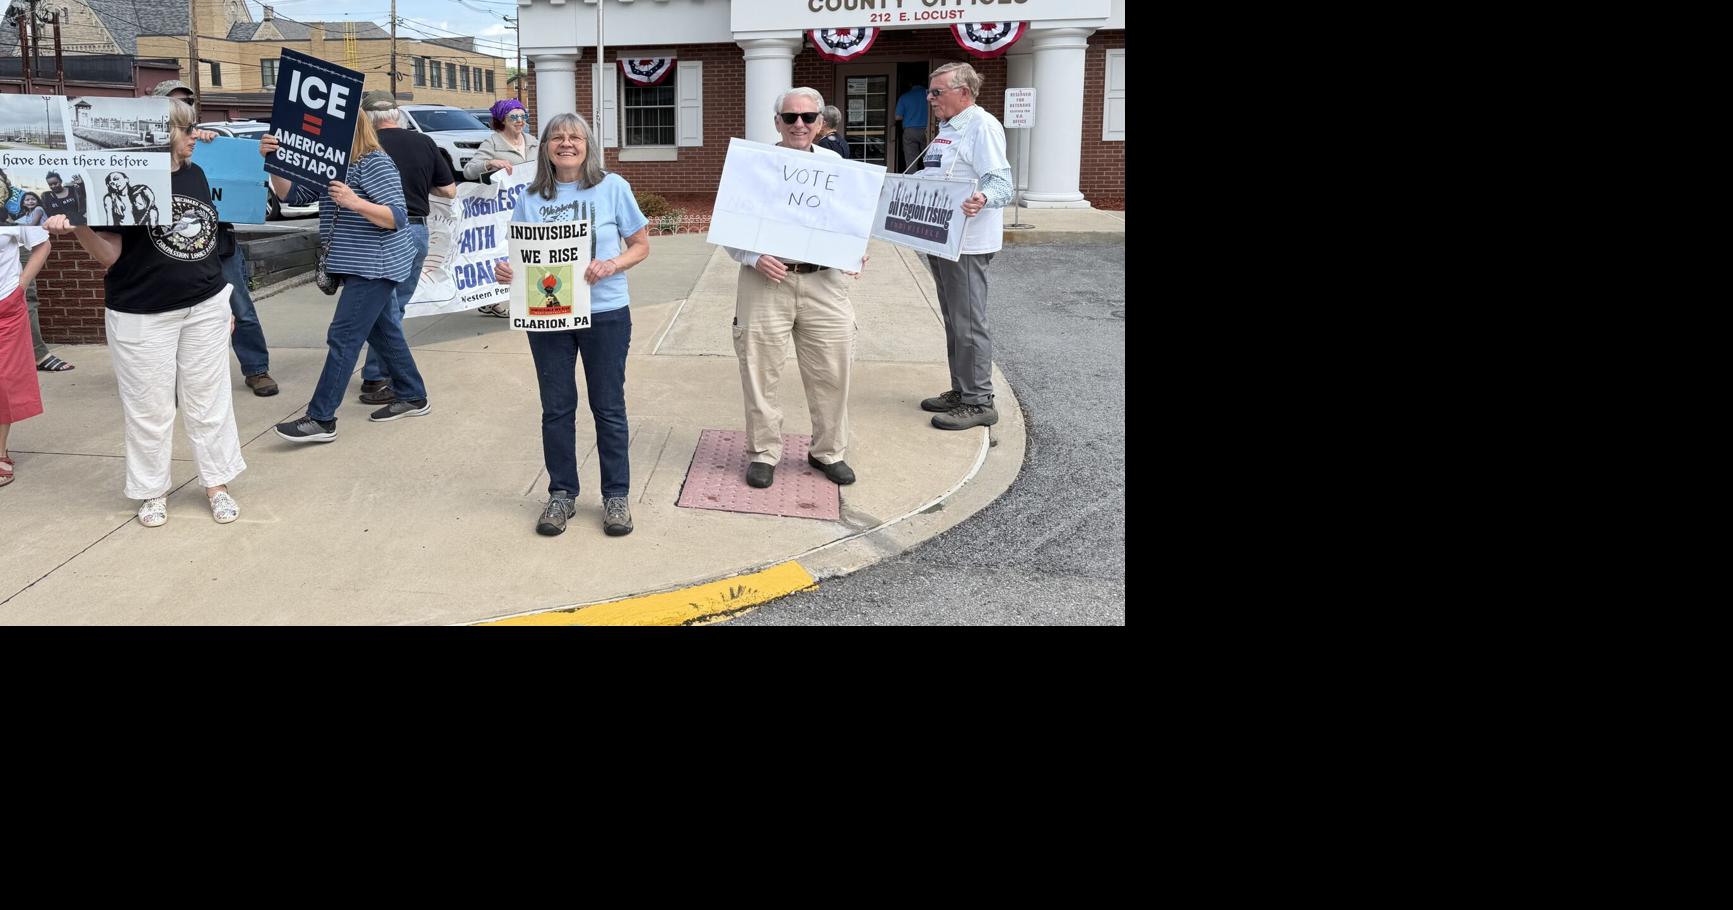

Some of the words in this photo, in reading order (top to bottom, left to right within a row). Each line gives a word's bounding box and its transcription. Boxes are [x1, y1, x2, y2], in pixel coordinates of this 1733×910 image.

[870, 13, 891, 22] 212
[899, 12, 910, 21] E.
[914, 9, 965, 20] LOCUST
[288, 69, 350, 120] ICE
[274, 128, 346, 166] AMERICAN
[3, 153, 35, 167] have
[39, 152, 68, 167] been
[73, 154, 106, 168] there
[110, 154, 149, 168] before
[276, 146, 337, 180] GESTAPO
[783, 164, 840, 191] VOTE
[788, 191, 821, 208] NO
[898, 202, 926, 222] region
[924, 206, 954, 230] rising
[457, 224, 497, 254] AITH
[510, 223, 588, 241] INDIVISIBLE
[520, 249, 541, 264] WE
[549, 247, 578, 264] RISE
[495, 287, 511, 296] Pen
[573, 316, 589, 327] PA
